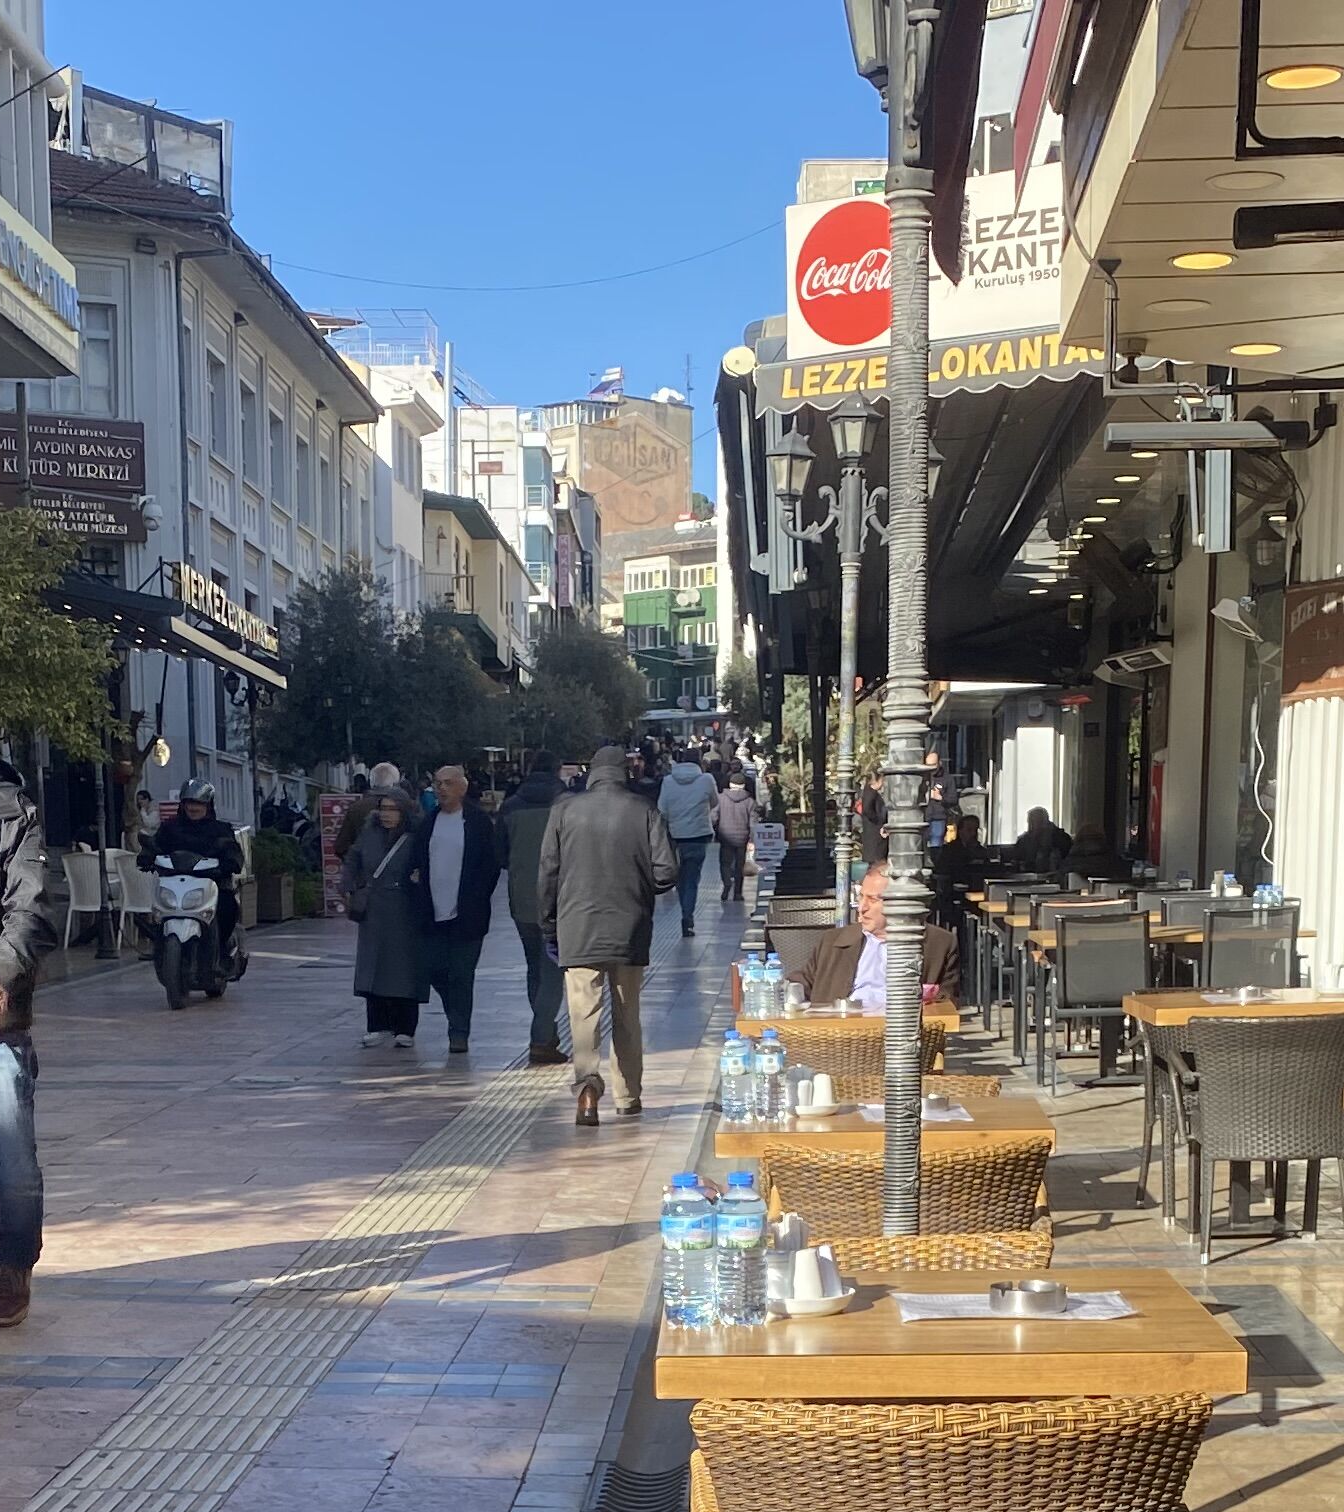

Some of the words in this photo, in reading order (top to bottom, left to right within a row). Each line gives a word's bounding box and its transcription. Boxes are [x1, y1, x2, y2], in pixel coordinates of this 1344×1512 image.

[965, 207, 1064, 245] EZZE
[975, 272, 1025, 289] Kuruluş
[1029, 268, 1060, 282] 1950
[781, 356, 889, 399] LEZZE
[34, 441, 75, 455] AYDIN
[67, 462, 130, 481] MERKEZİ
[90, 523, 129, 536] MÜZESİ
